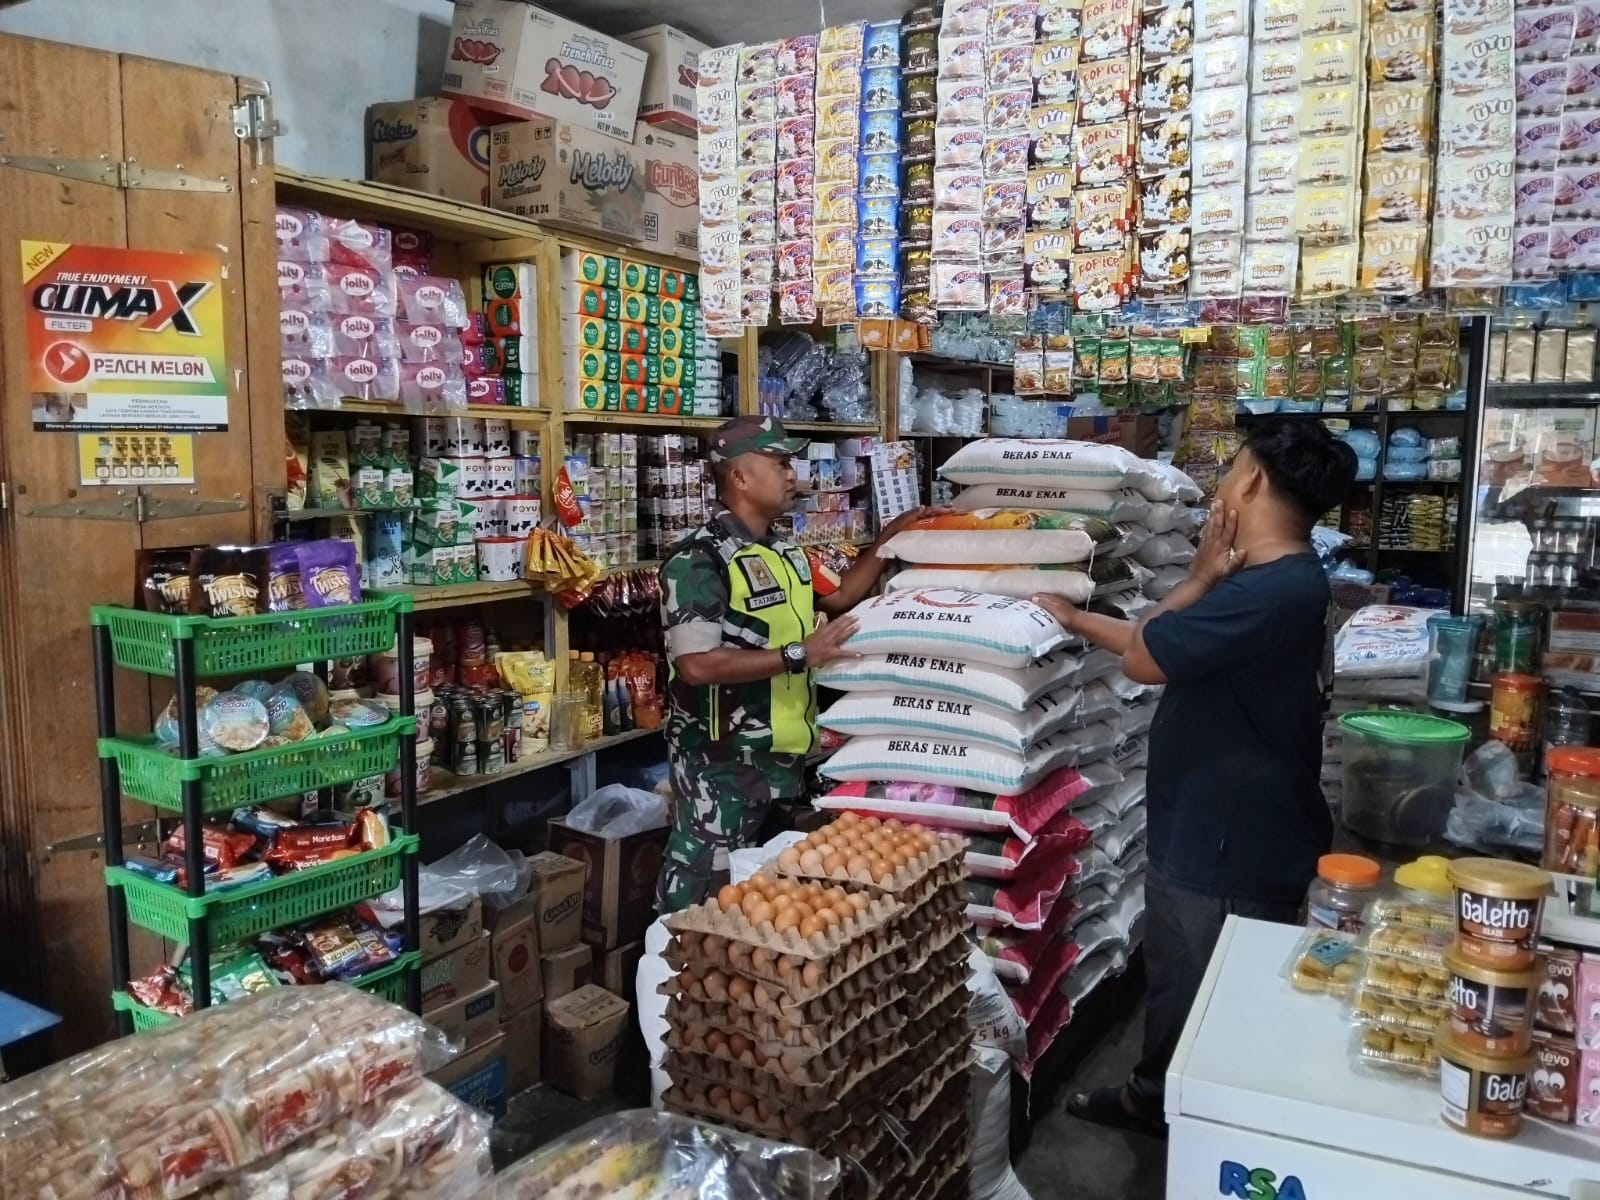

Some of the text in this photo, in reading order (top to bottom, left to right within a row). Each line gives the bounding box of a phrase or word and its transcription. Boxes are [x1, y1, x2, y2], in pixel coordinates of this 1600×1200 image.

[1386, 23, 1426, 46] UYU
[560, 42, 615, 69] French Fries
[1041, 45, 1072, 66] UYU
[1472, 35, 1512, 58] UYU
[1083, 69, 1102, 83] POP
[1385, 95, 1423, 117] UYU
[1473, 98, 1513, 122] UYU
[1037, 109, 1068, 129] UYU
[1081, 133, 1101, 147] POP
[499, 154, 546, 188] Melody
[570, 149, 634, 194] Melody
[1383, 165, 1420, 186] UYU
[1474, 160, 1513, 182] UYU
[1036, 171, 1065, 193] UYU
[276, 219, 298, 233] olly
[1472, 224, 1511, 245] UYU
[1033, 234, 1065, 253] UYU
[1378, 235, 1418, 256] UYU
[26, 245, 55, 271] NEW
[1078, 259, 1098, 275] POP
[56, 272, 148, 285] TRUE ENJOYMENT
[278, 267, 299, 279] olly
[343, 277, 370, 293] jolly
[32, 280, 215, 337] CLIMAX
[51, 321, 87, 330] FILTER
[281, 315, 305, 328] olly
[343, 321, 370, 336] jolly
[414, 330, 439, 344] jolly
[94, 359, 204, 377] PEACH MELON
[284, 365, 307, 380] olly
[348, 364, 374, 379] jolly
[419, 370, 443, 385] jolly
[1002, 450, 1073, 460] BERAS ENAK
[488, 465, 513, 473] FOYU
[996, 488, 1067, 499] BERAS ENAK
[512, 505, 537, 513] FOYU
[269, 582, 303, 602] Twis
[309, 574, 350, 596] Twiste
[754, 593, 778, 606] TATANG
[892, 610, 973, 624] BERAS ENAK
[885, 653, 967, 674] BERAS ENAK
[215, 700, 256, 709] Sedaap
[892, 695, 973, 716] BERAS ENAK
[887, 740, 969, 757] BERAS ENAK
[312, 835, 331, 843] Marie
[1461, 892, 1529, 929] Galetto
[1450, 976, 1477, 1010] etto
[993, 1025, 1009, 1039] kg
[1486, 1074, 1527, 1101] Gale
[1218, 1160, 1306, 1200] RSA
